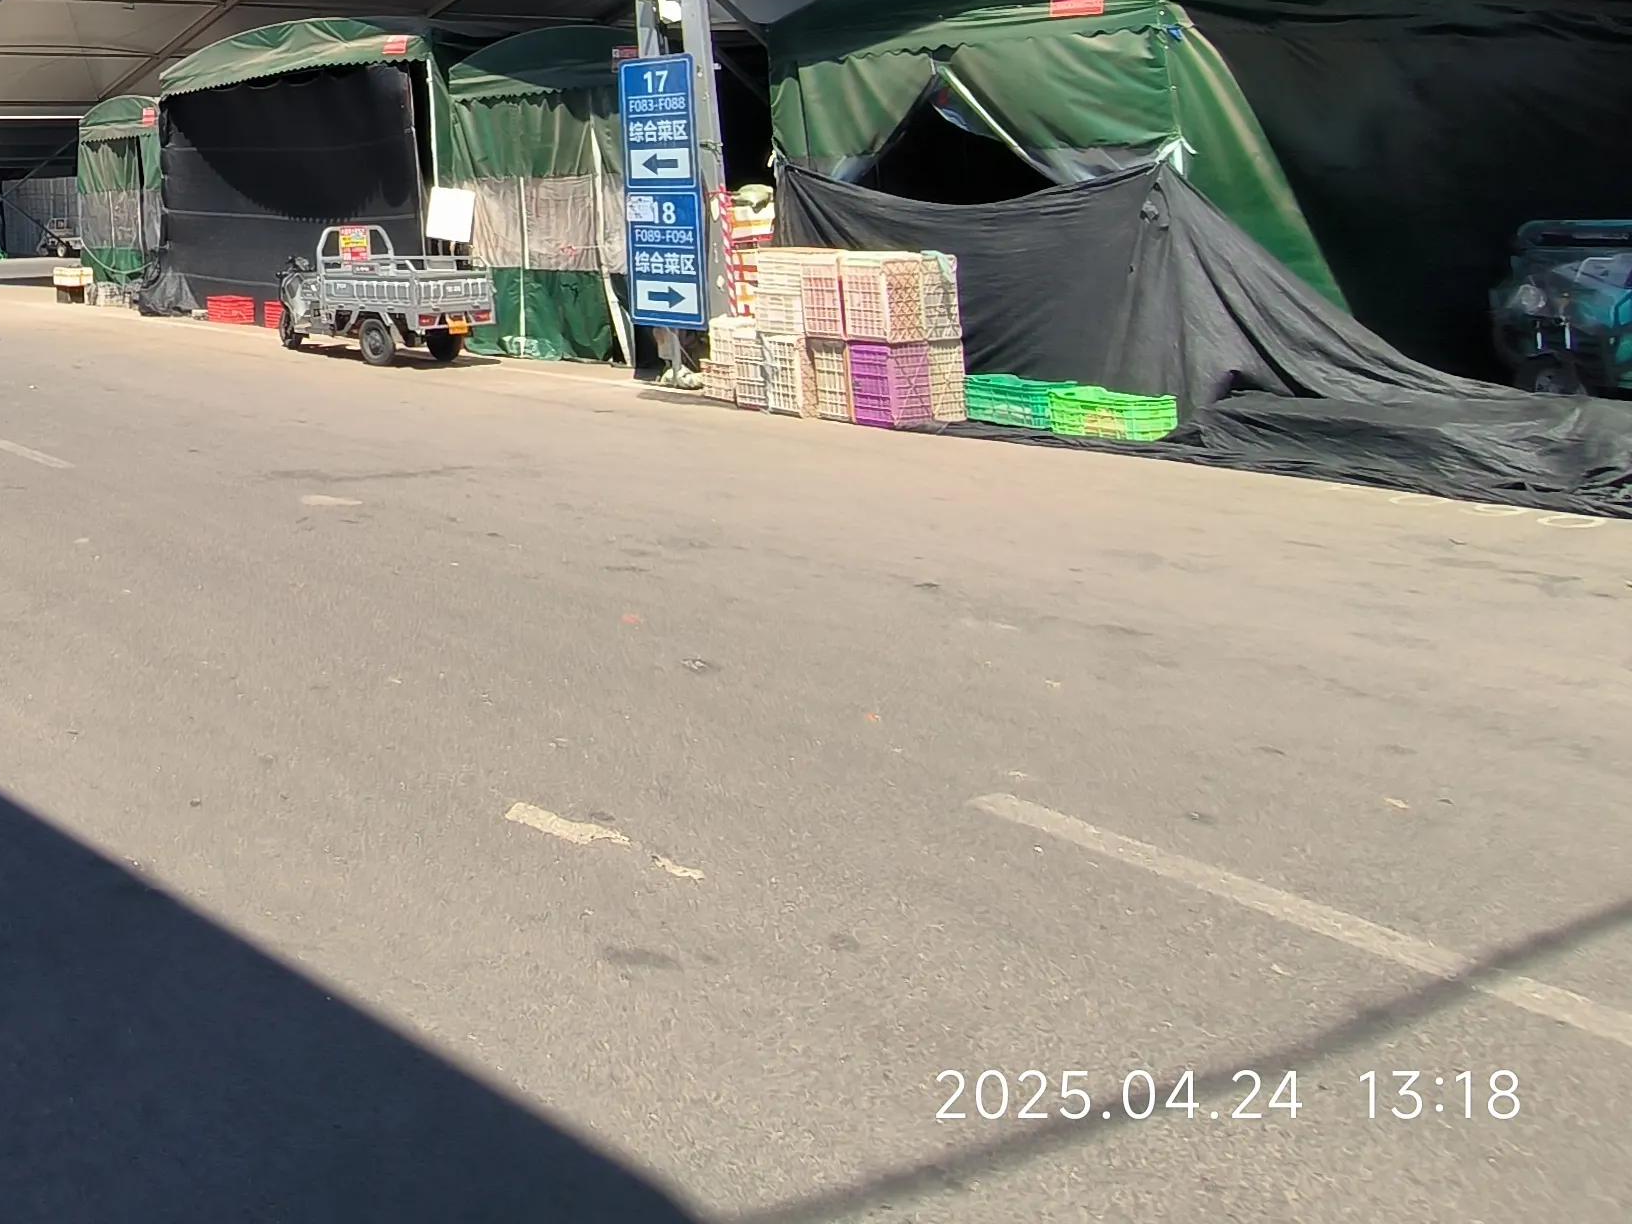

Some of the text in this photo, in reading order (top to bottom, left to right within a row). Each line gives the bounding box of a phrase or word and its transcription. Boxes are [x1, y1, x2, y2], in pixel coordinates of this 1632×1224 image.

[643, 70, 668, 94] 17
[628, 96, 686, 113] F083-F088
[628, 119, 688, 143] 综合菜区
[652, 201, 676, 224] 18
[634, 226, 694, 245] F089-F094
[634, 251, 696, 276] 综合菜区
